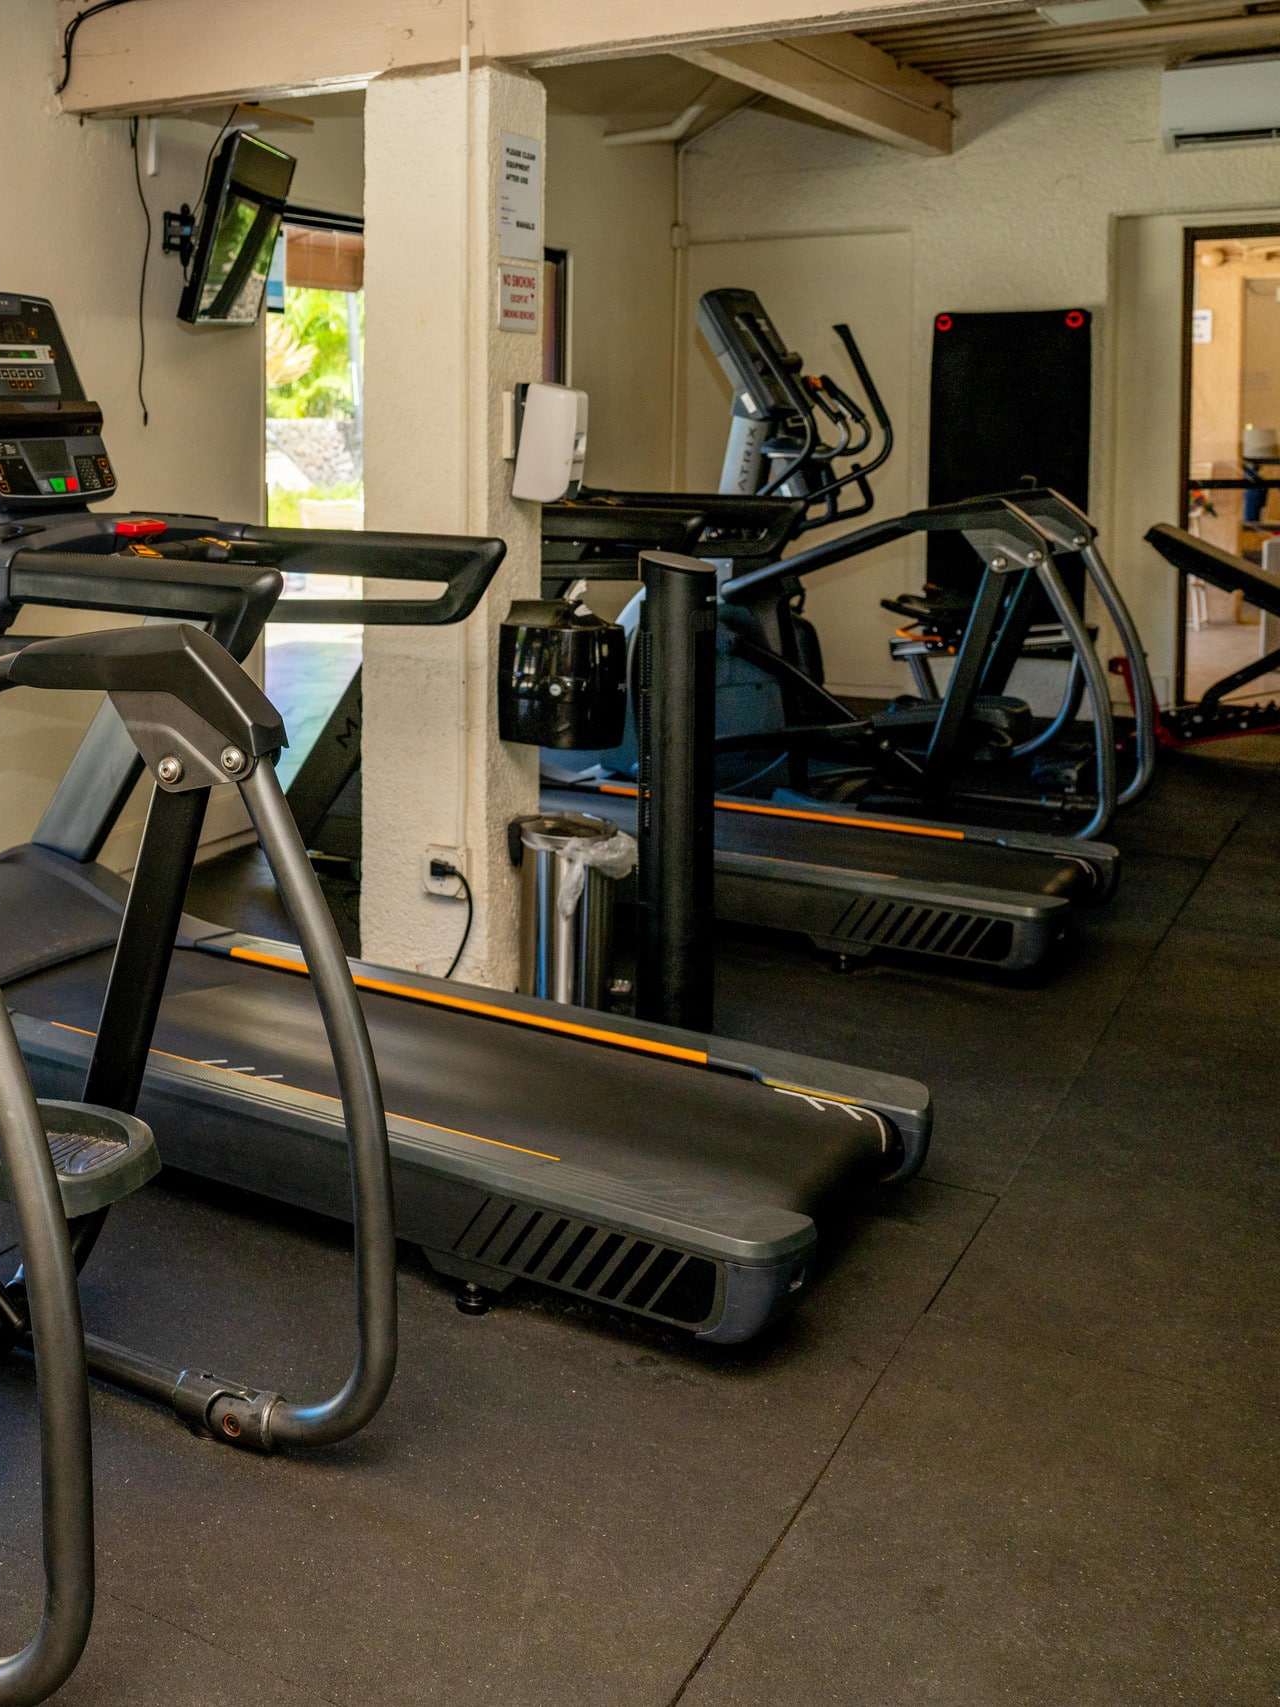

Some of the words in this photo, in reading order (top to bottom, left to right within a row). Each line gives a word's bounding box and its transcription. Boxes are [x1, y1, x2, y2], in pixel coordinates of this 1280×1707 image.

[505, 147, 521, 157] PLEASE
[503, 273, 510, 286] NO
[512, 274, 535, 290] SMOKING
[737, 427, 757, 492] ATRIX
